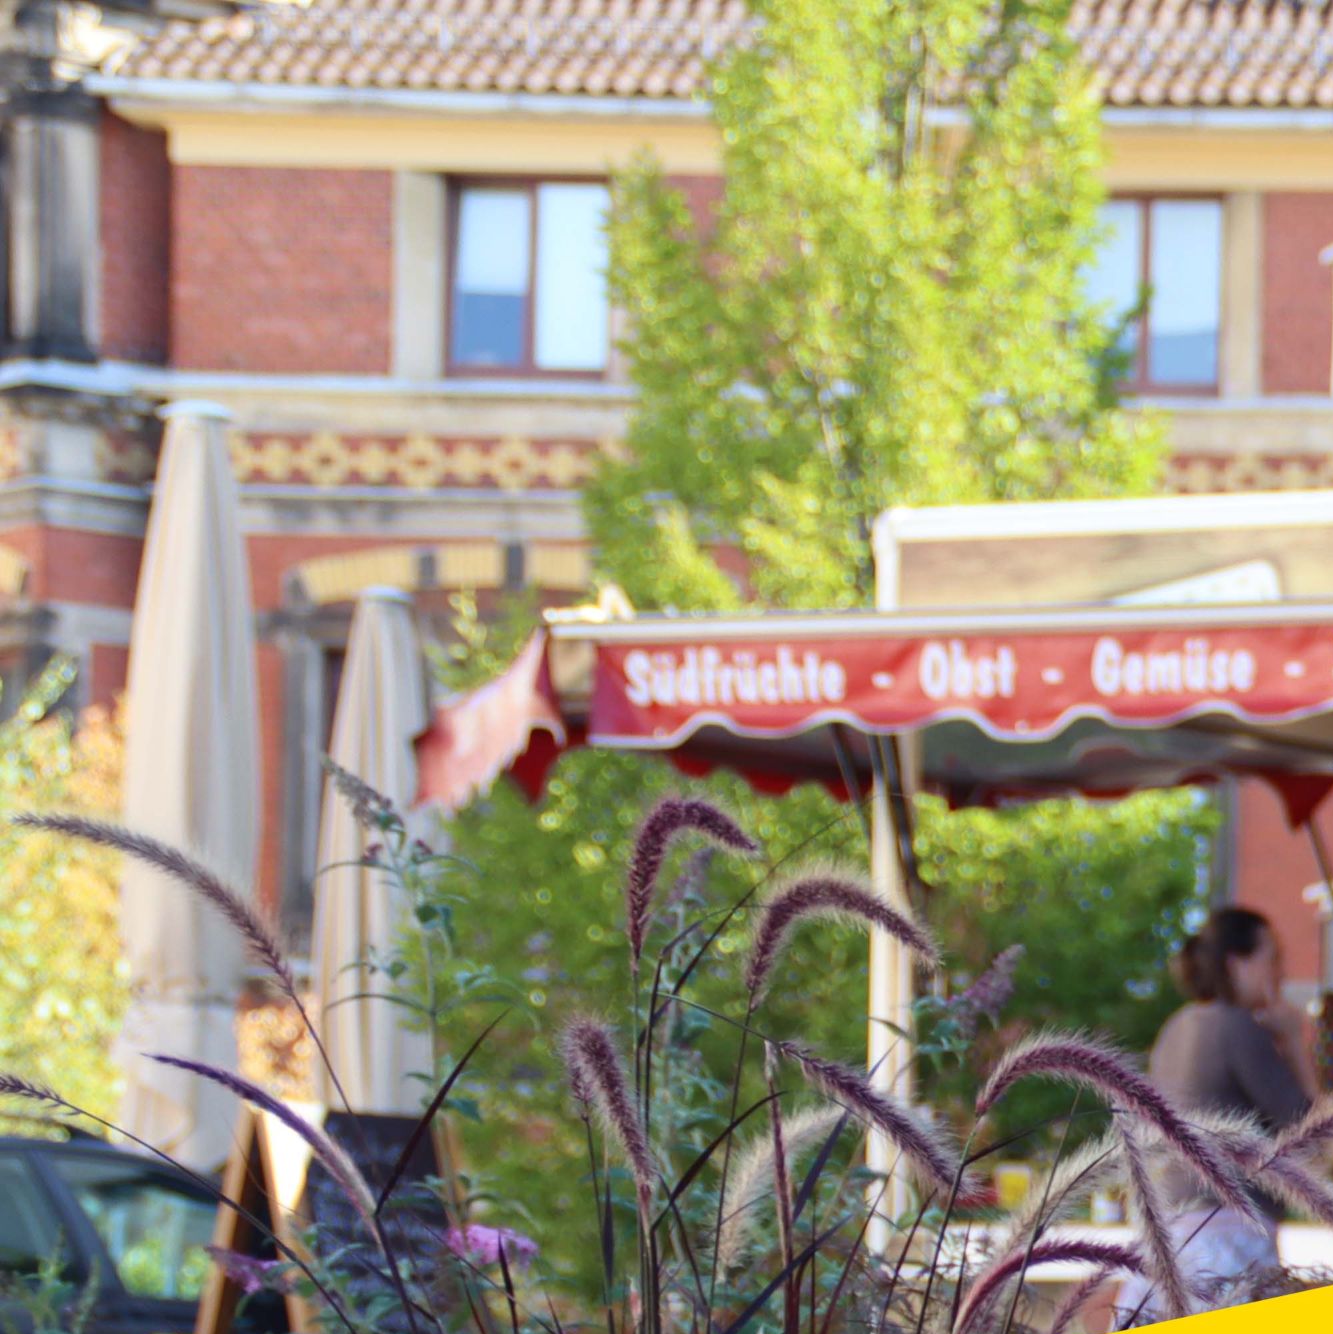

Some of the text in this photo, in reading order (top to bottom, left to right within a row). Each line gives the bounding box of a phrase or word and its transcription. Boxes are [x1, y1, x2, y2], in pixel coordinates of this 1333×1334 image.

[624, 646, 846, 706] Südfrüchte
[919, 642, 1017, 698] Obst
[1092, 637, 1255, 696] Gemüse
